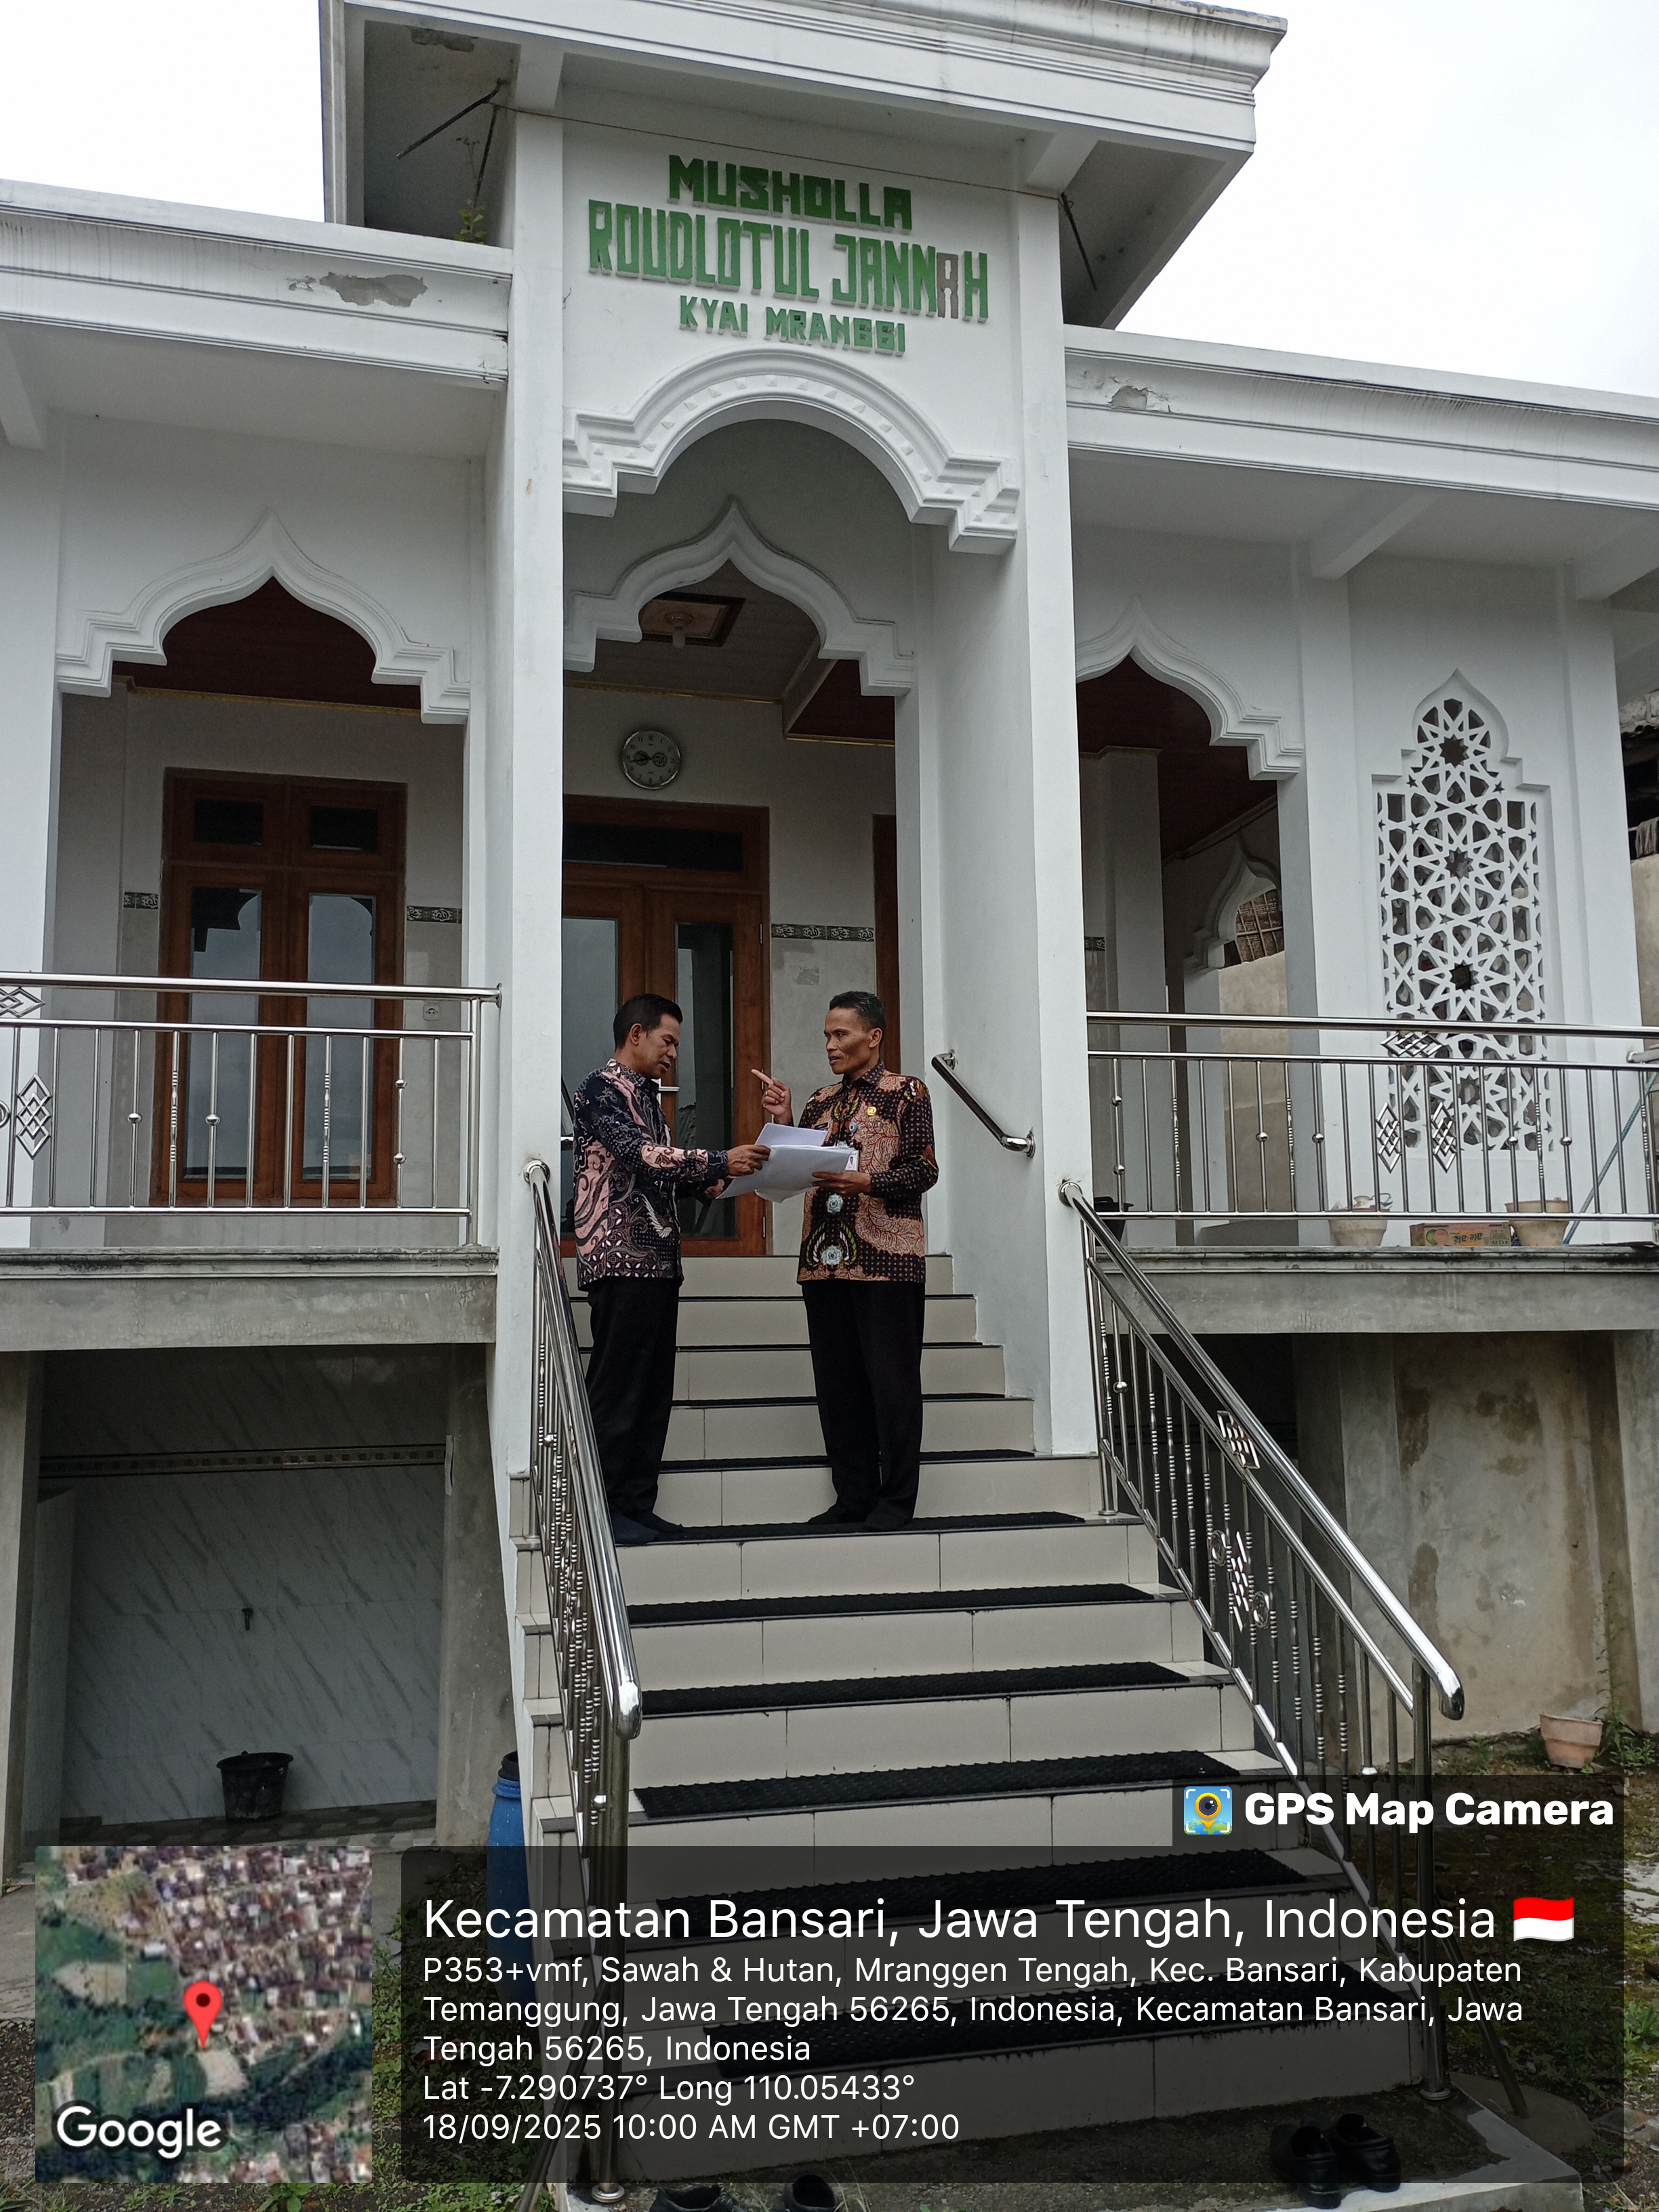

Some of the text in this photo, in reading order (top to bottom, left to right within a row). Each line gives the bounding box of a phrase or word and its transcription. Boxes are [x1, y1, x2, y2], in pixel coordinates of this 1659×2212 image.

[668, 155, 912, 233] MUSHOLLA
[588, 199, 988, 323] ROUDLOTUL JANNAH
[679, 295, 747, 337] KYAI
